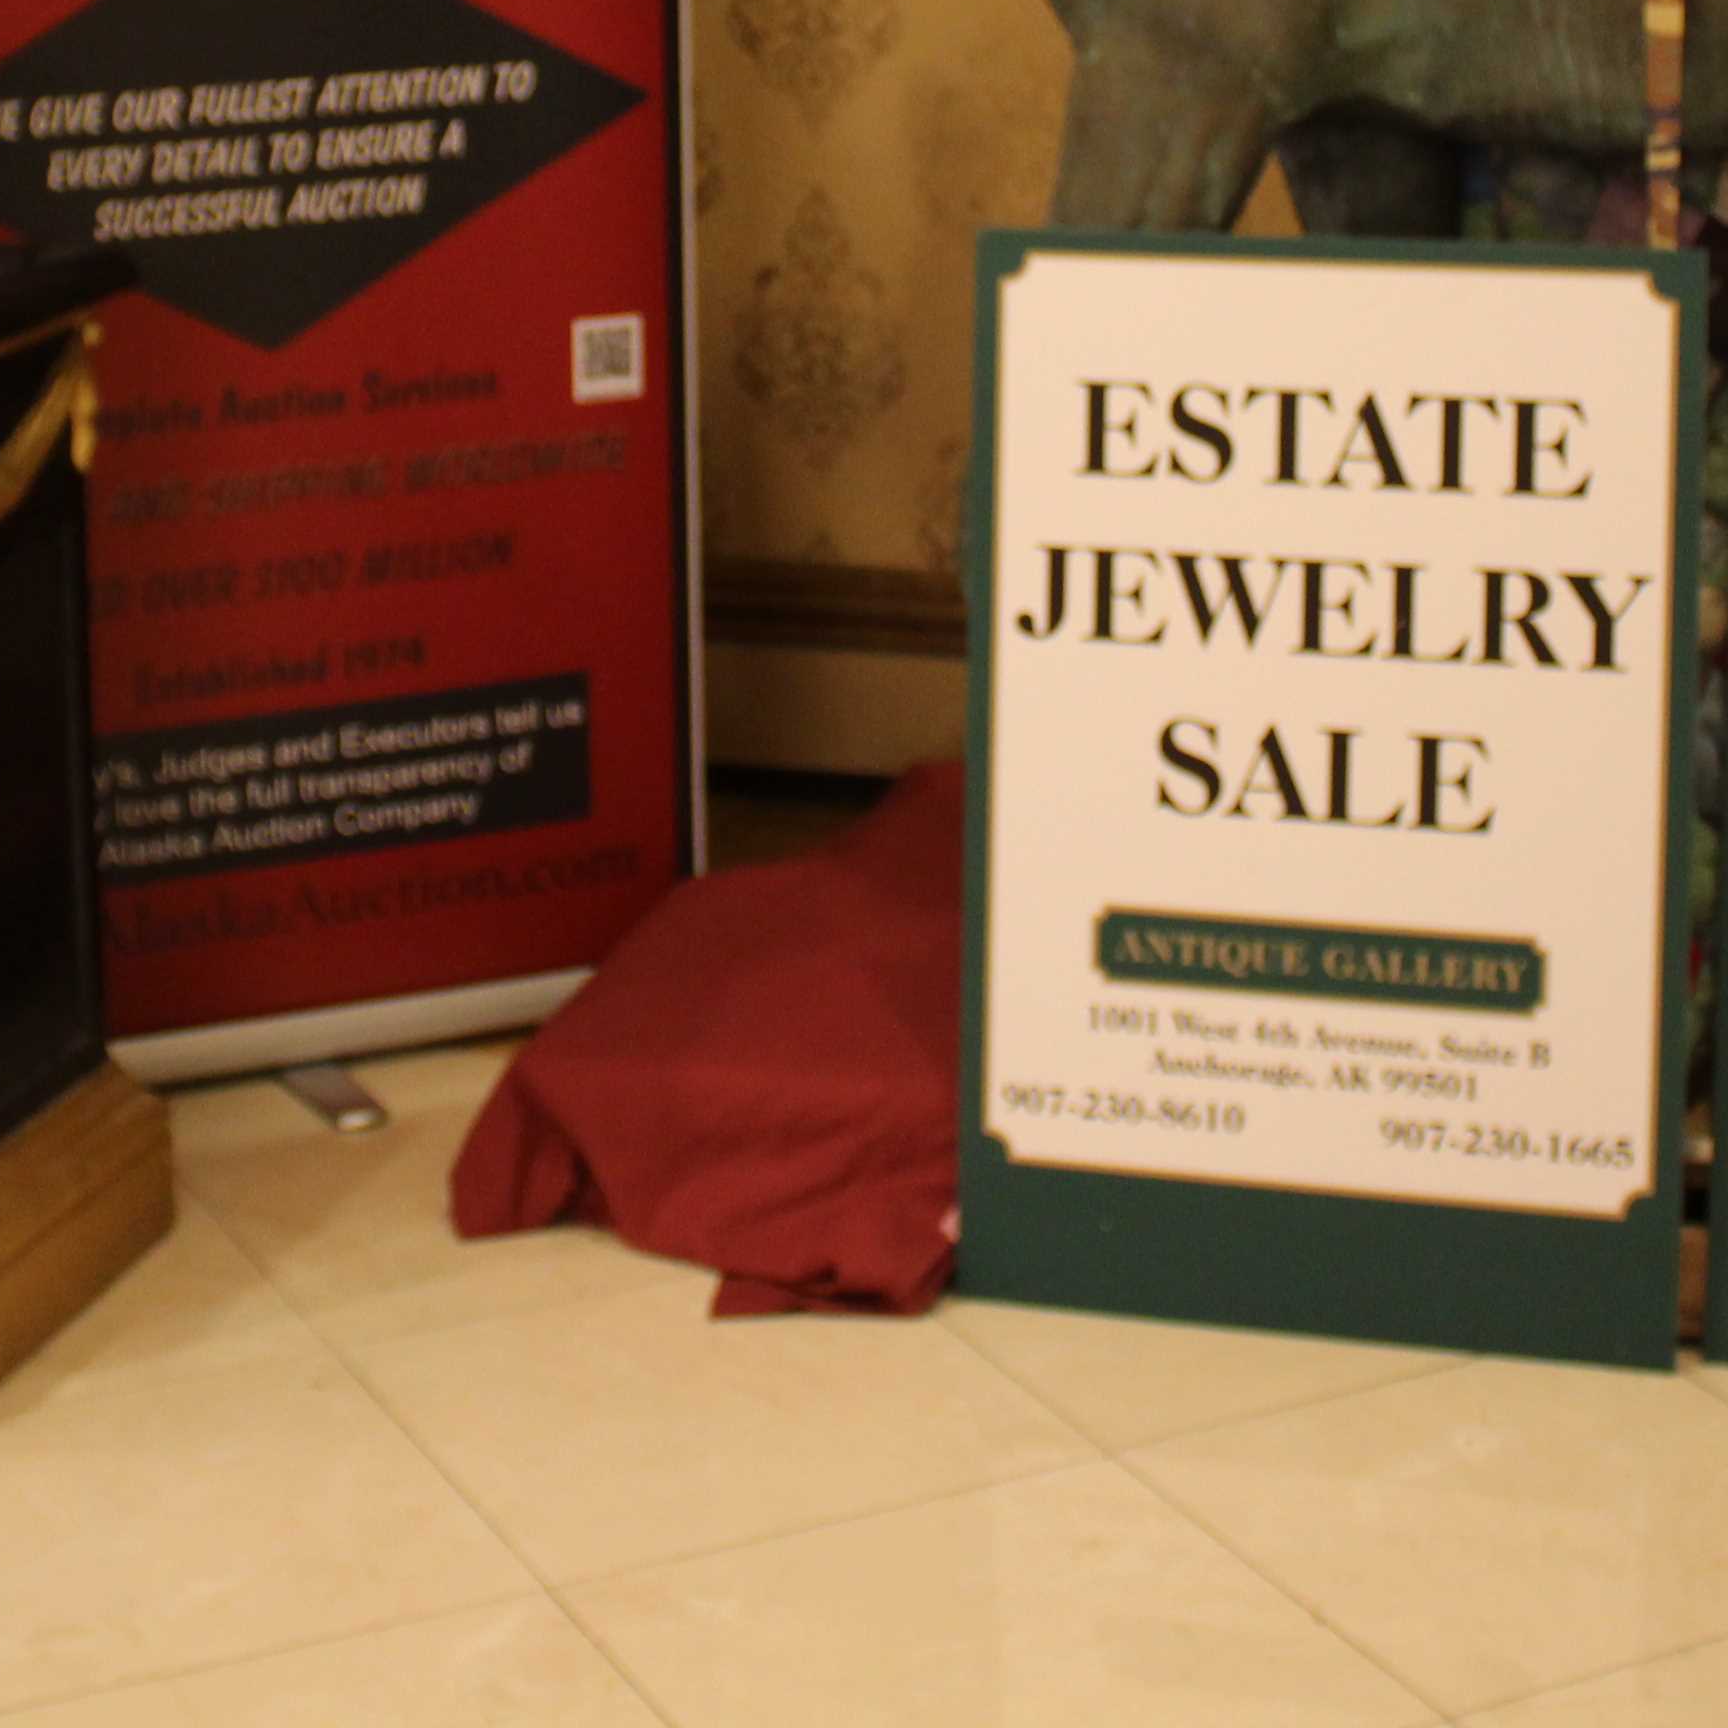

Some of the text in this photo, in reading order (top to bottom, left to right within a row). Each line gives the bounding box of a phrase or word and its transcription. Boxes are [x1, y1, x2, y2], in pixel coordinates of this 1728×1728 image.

[29, 94, 105, 139] GIVE
[112, 87, 181, 131] OUR
[188, 77, 311, 128] FULLEST
[316, 66, 486, 117] ATTENTION
[493, 60, 538, 104] TO
[46, 120, 467, 193] EVERY DETAIL TO ENSURE A
[93, 174, 428, 243] SUCCESSFUL AUCTION
[1076, 379, 1593, 500] ESTATE
[1015, 543, 1655, 673] JEWELRY
[155, 745, 268, 784] Judges
[273, 733, 334, 770] and
[339, 716, 491, 760] Executors
[496, 702, 541, 736] tell
[545, 702, 584, 729] us
[1157, 715, 1496, 834] SALE
[115, 797, 183, 828] love
[188, 786, 239, 819] the
[247, 776, 295, 809] full
[299, 751, 494, 802] transparency
[499, 741, 535, 774] of
[98, 792, 484, 868] Alaska Auction Company
[1115, 927, 1528, 996] ANTIQUE GALLERY
[1087, 1003, 1160, 1036] 1001
[1171, 1009, 1238, 1043] West
[1254, 1014, 1299, 1049] 4th
[1440, 1035, 1515, 1067] Suite
[1530, 1042, 1552, 1069] B
[1325, 1064, 1371, 1093] AK
[1382, 1067, 1478, 1102] 99501
[1002, 1084, 1634, 1170] 907-230-8610 907-230-1665
